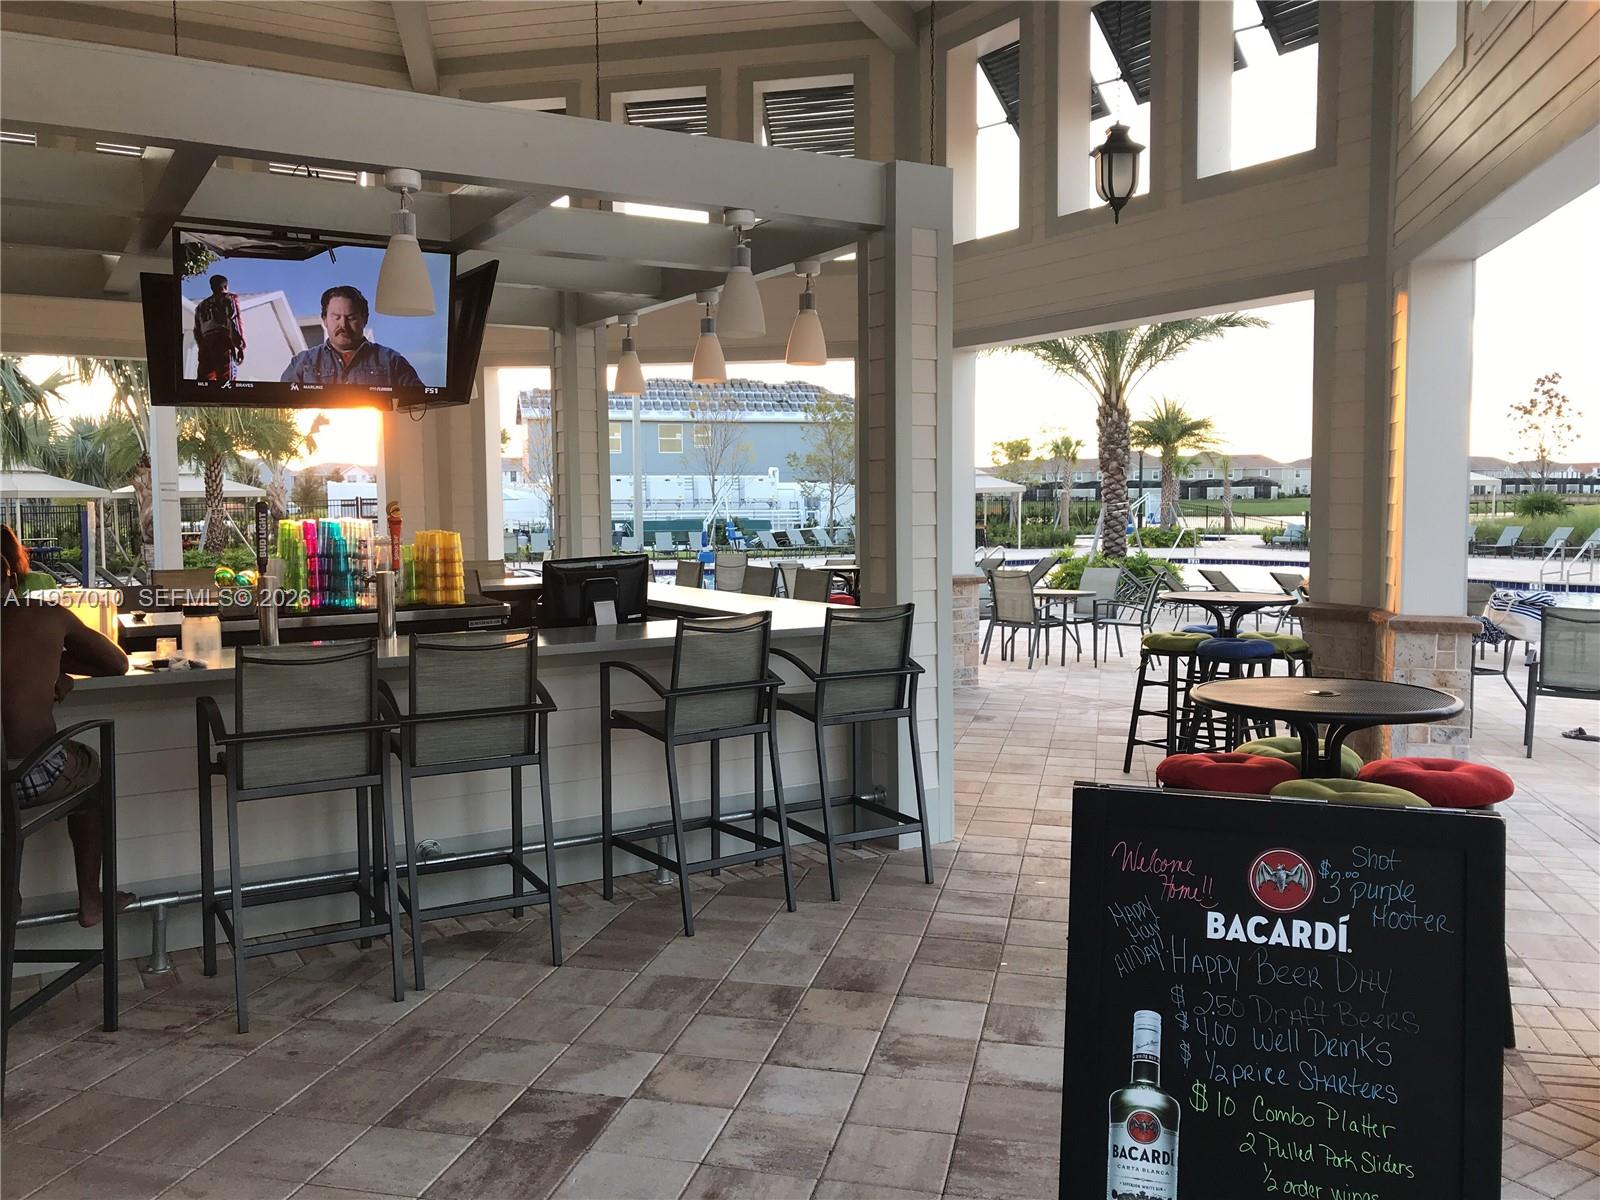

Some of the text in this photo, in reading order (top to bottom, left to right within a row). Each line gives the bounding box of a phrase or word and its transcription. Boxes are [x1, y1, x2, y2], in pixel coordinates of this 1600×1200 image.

[258, 511, 267, 539] LIGHT
[1111, 841, 1196, 876] Welcome
[1352, 845, 1402, 871] Shot
[1252, 1095, 1315, 1127] Combo
[1316, 1101, 1396, 1139] Platter
[1239, 1132, 1257, 1156] 2
[1258, 1131, 1315, 1162] Pulled
[1360, 1151, 1415, 1179] Sliders
